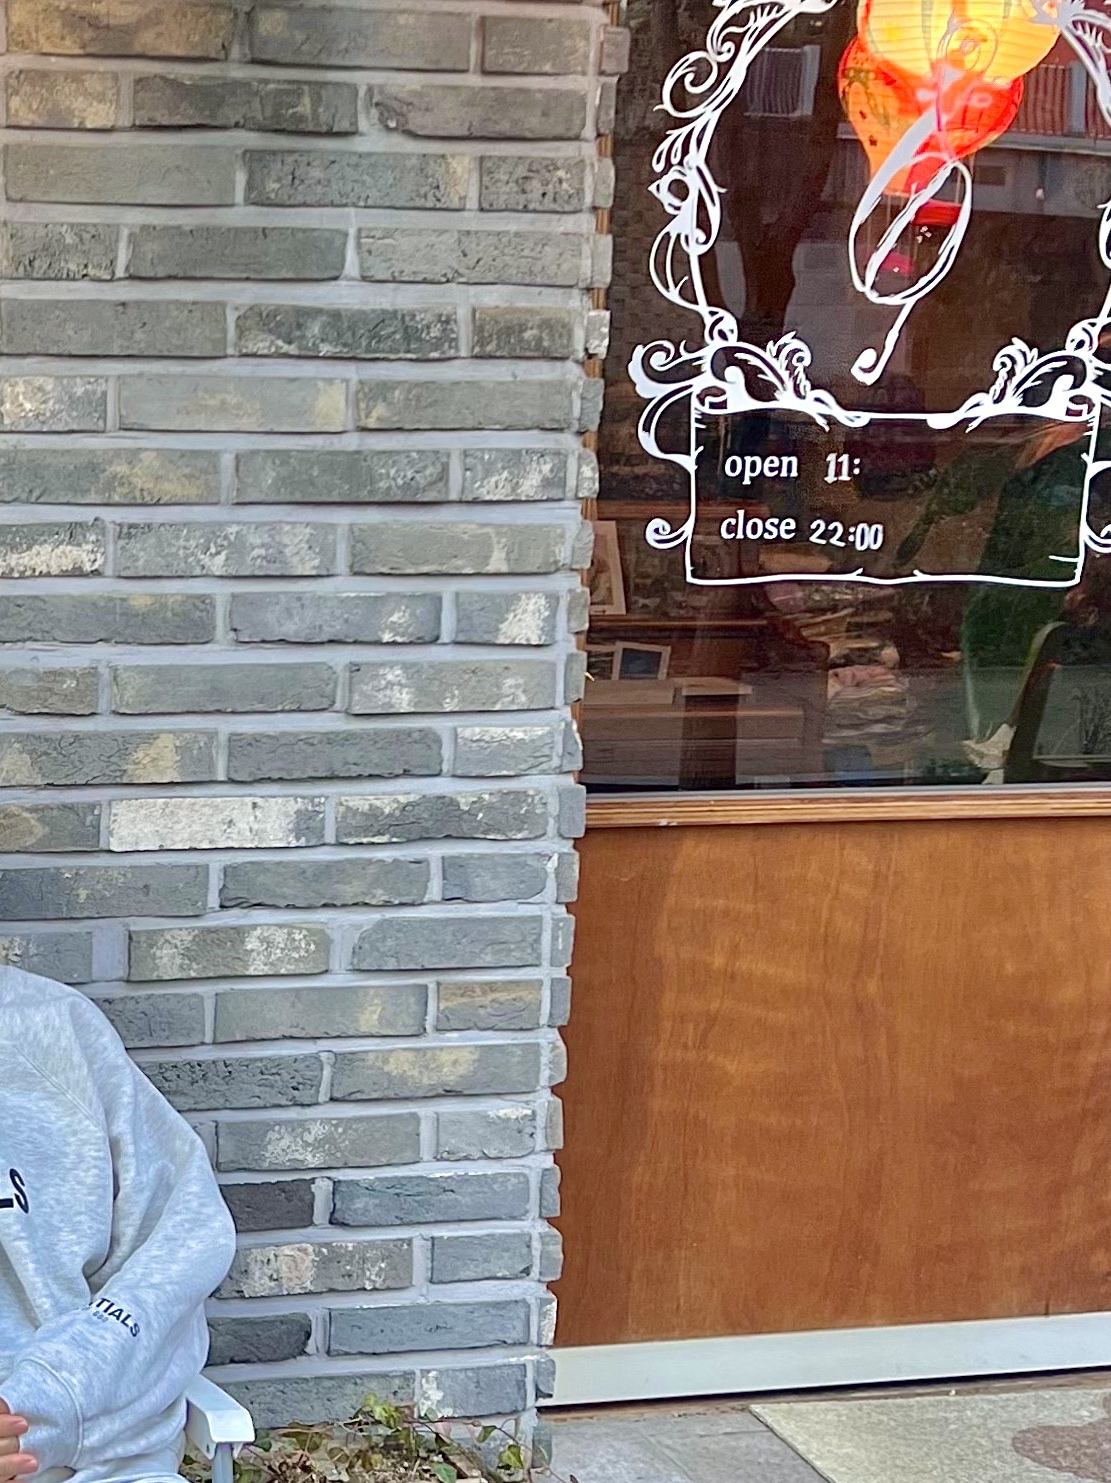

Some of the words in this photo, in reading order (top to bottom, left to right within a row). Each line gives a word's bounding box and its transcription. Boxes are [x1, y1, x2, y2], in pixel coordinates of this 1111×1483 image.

[724, 454, 799, 485] open
[824, 453, 861, 484] 11:
[720, 509, 797, 540] close
[808, 519, 884, 551] 22:00
[89, 1297, 140, 1337] TIALS
